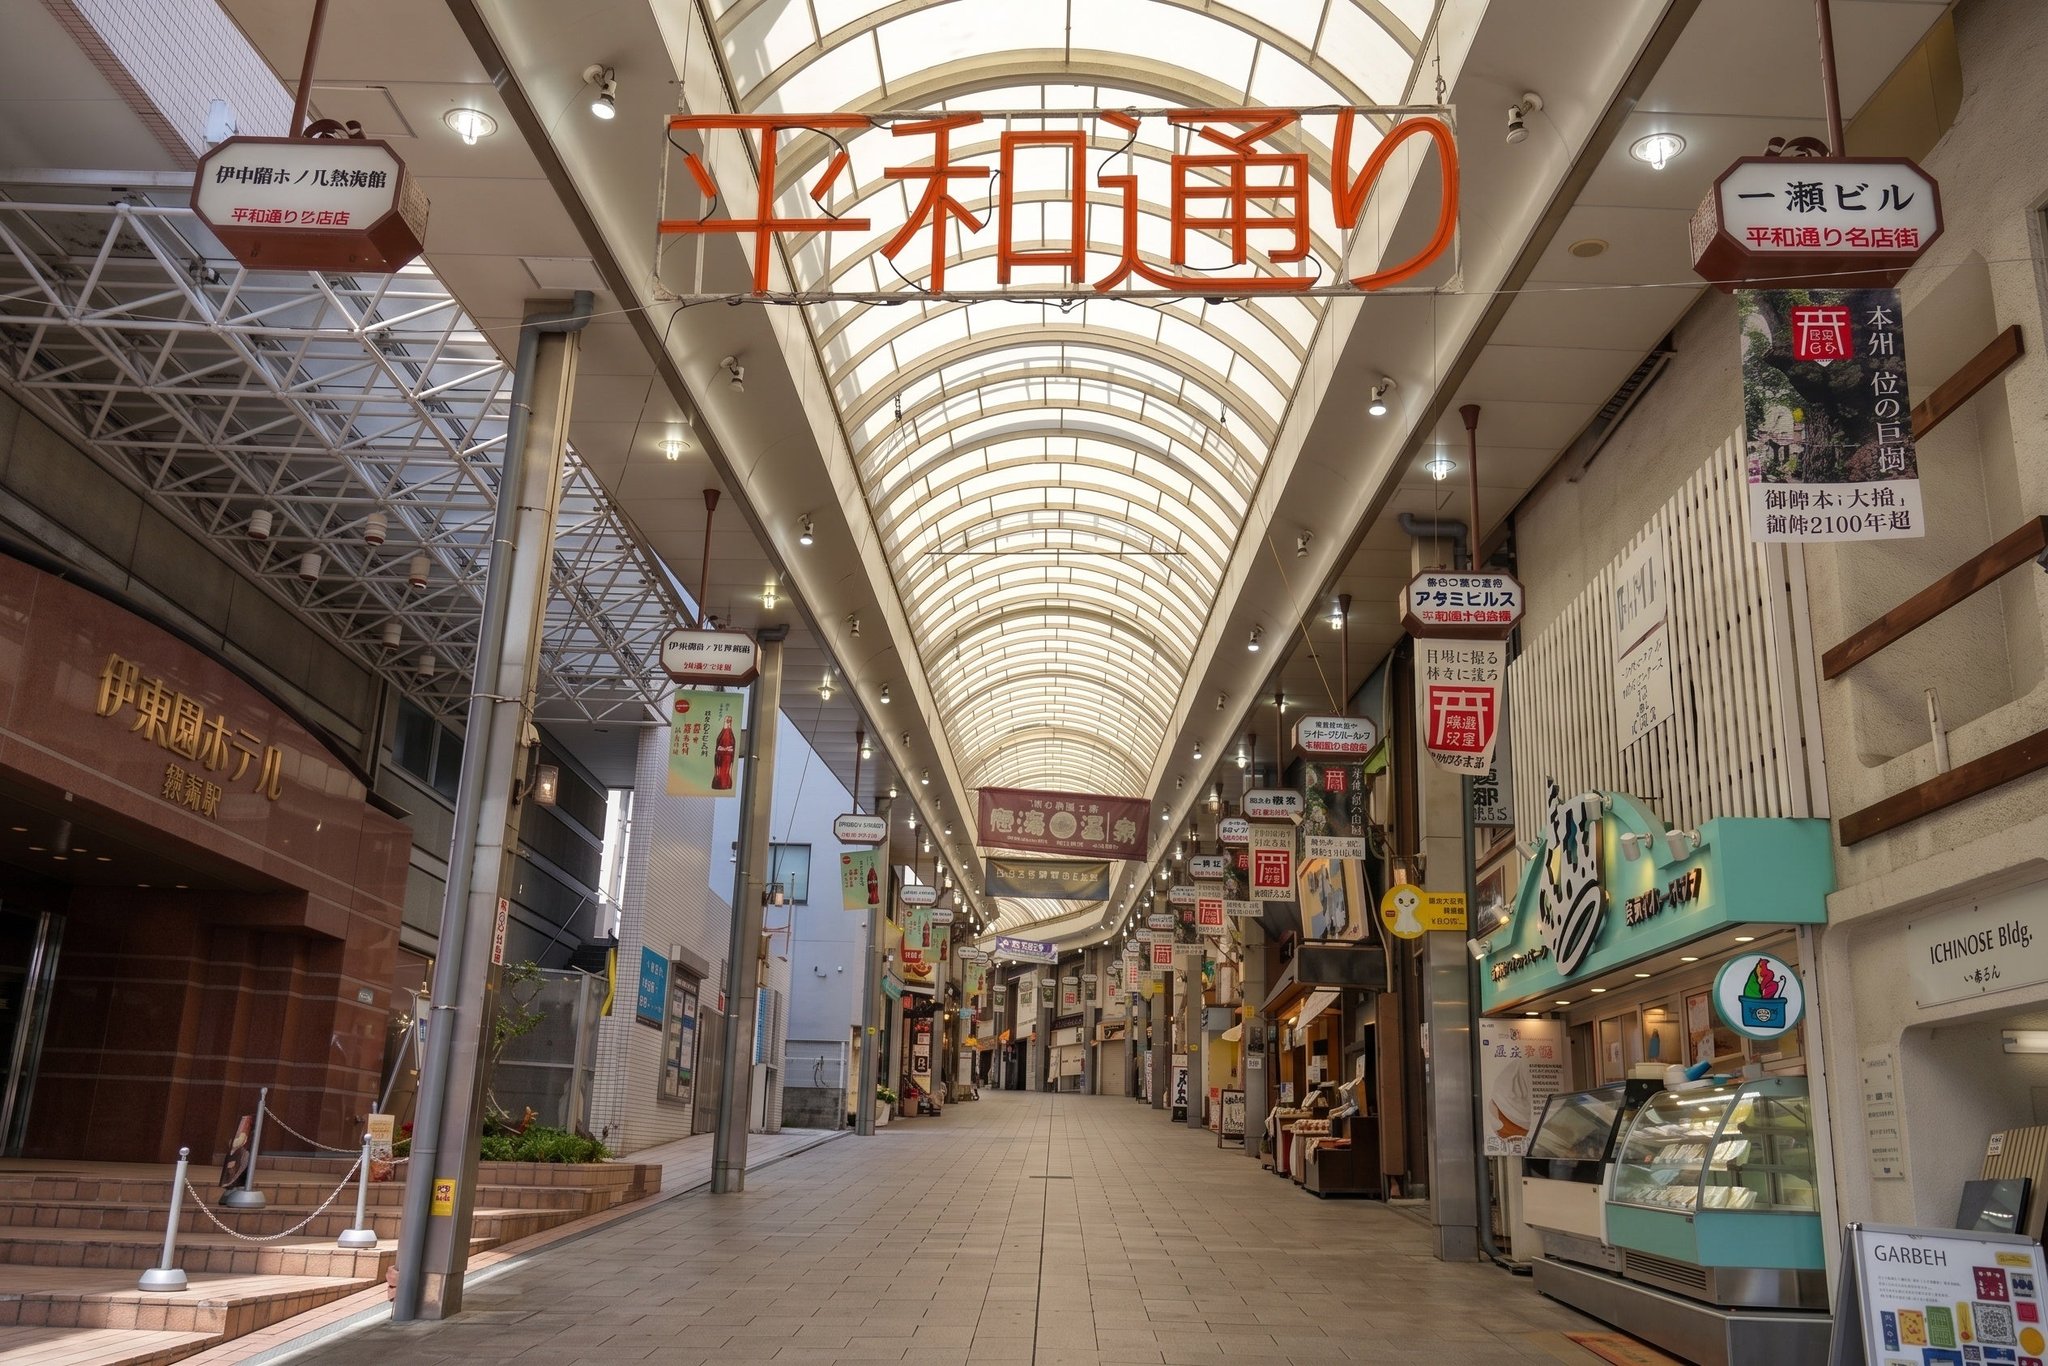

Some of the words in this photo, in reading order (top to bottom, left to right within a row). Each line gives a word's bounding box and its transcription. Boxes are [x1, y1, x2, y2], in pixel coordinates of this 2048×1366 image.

[658, 107, 1461, 295] 平和通り
[1738, 181, 1915, 213] 一瀬ビル
[1746, 226, 1919, 248] 平和通り名店街
[1930, 930, 1994, 965] ICHINOSE
[1998, 920, 2033, 948] Bldg.
[1874, 1244, 1947, 1267] GARBEH
